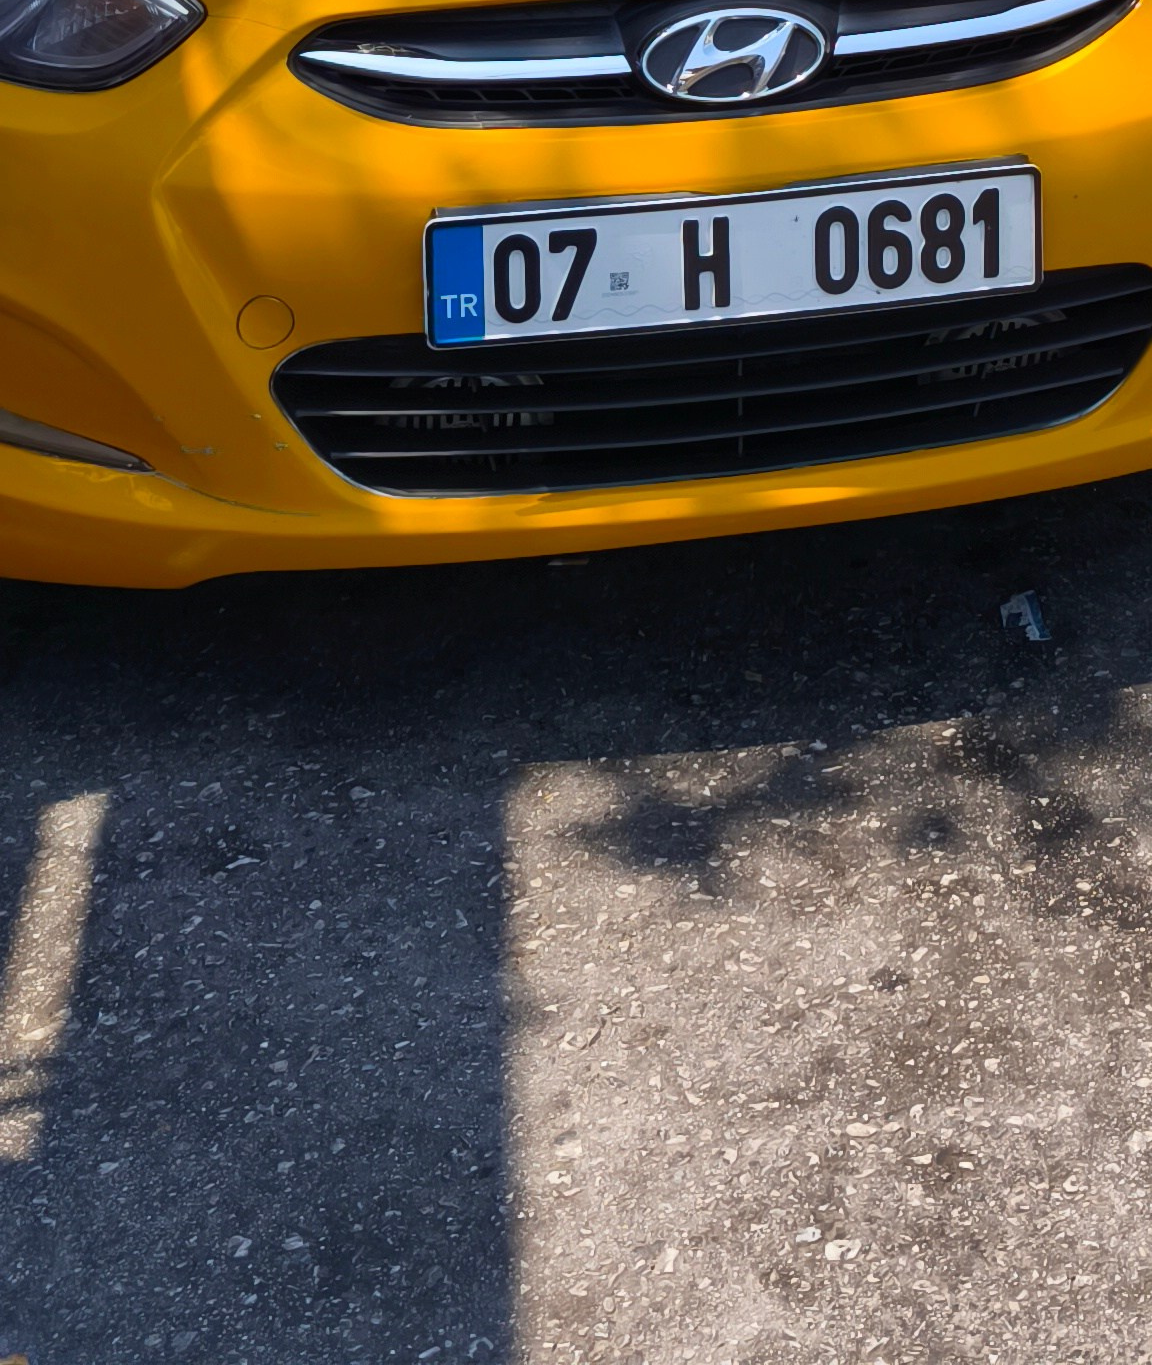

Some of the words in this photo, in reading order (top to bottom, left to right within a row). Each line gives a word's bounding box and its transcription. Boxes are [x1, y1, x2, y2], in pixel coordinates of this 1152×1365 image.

[493, 228, 598, 324] 07
[682, 216, 731, 311] H
[814, 187, 1001, 295] 0681
[440, 293, 478, 319] TR
